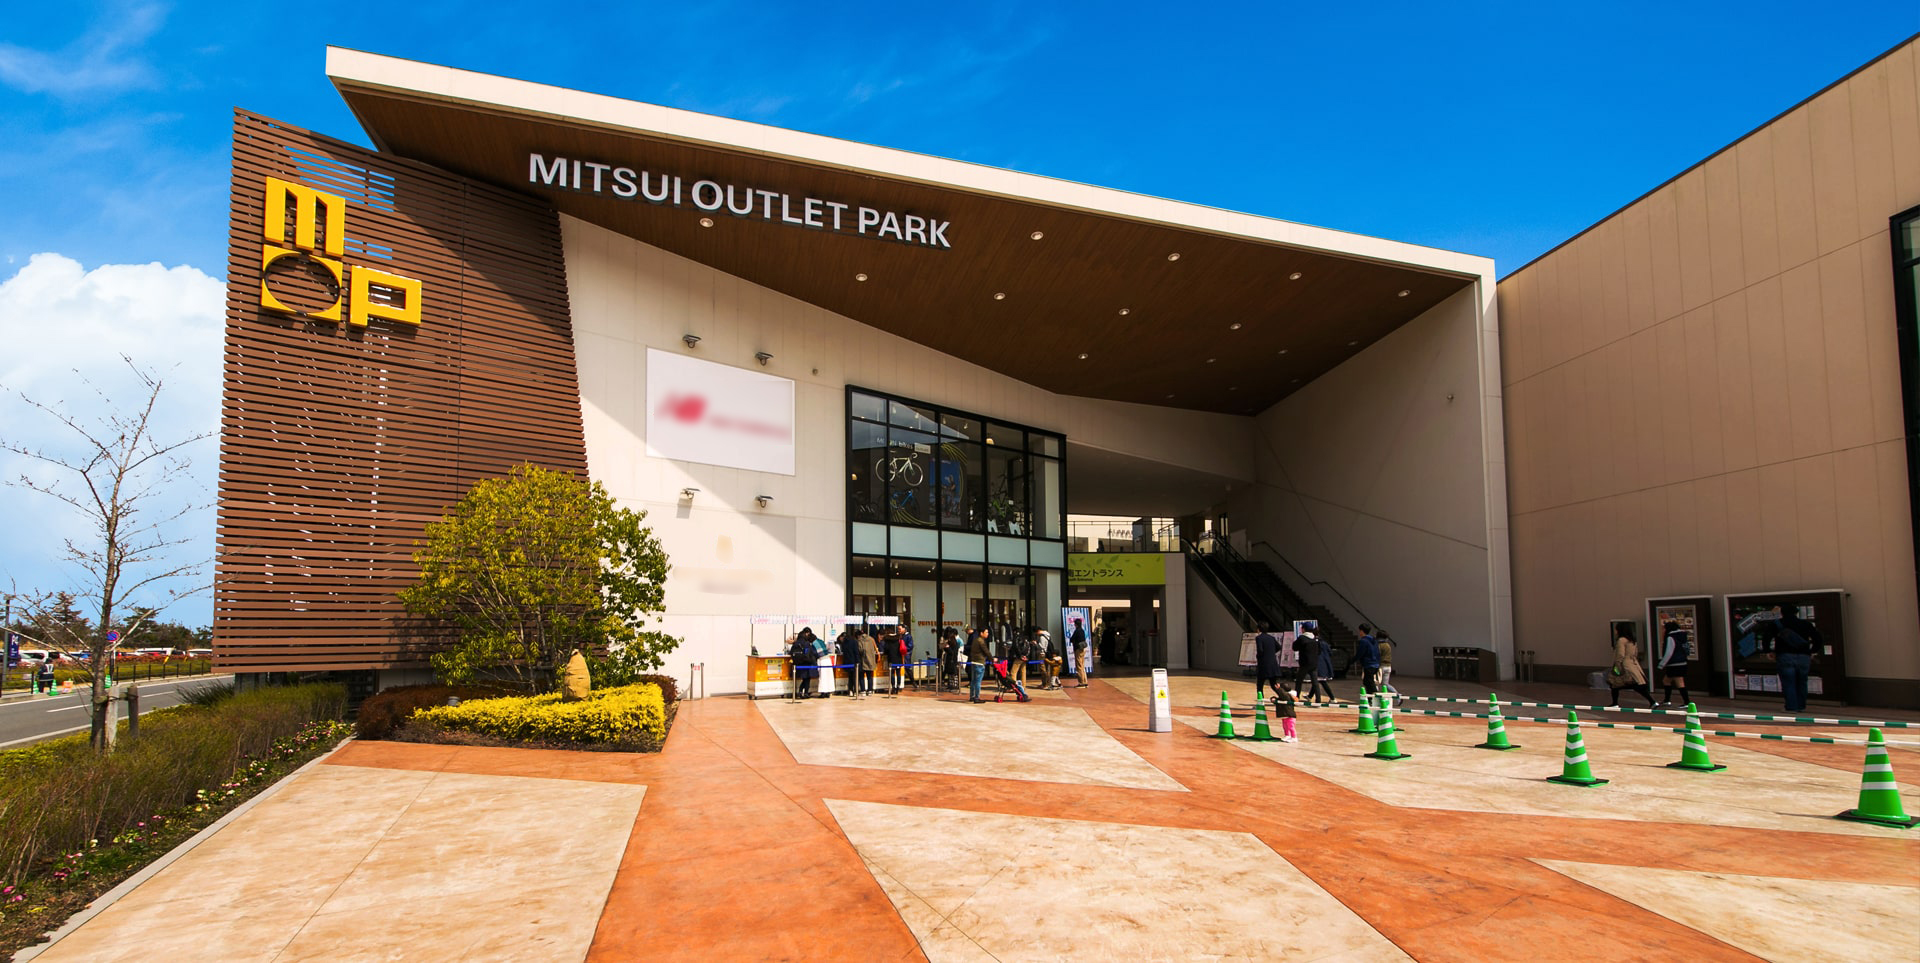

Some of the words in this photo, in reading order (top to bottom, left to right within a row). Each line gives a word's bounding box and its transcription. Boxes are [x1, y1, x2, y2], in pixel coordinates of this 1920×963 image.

[529, 153, 681, 206] MITSUI
[691, 180, 848, 231] OUTLET
[858, 206, 951, 248] PARK
